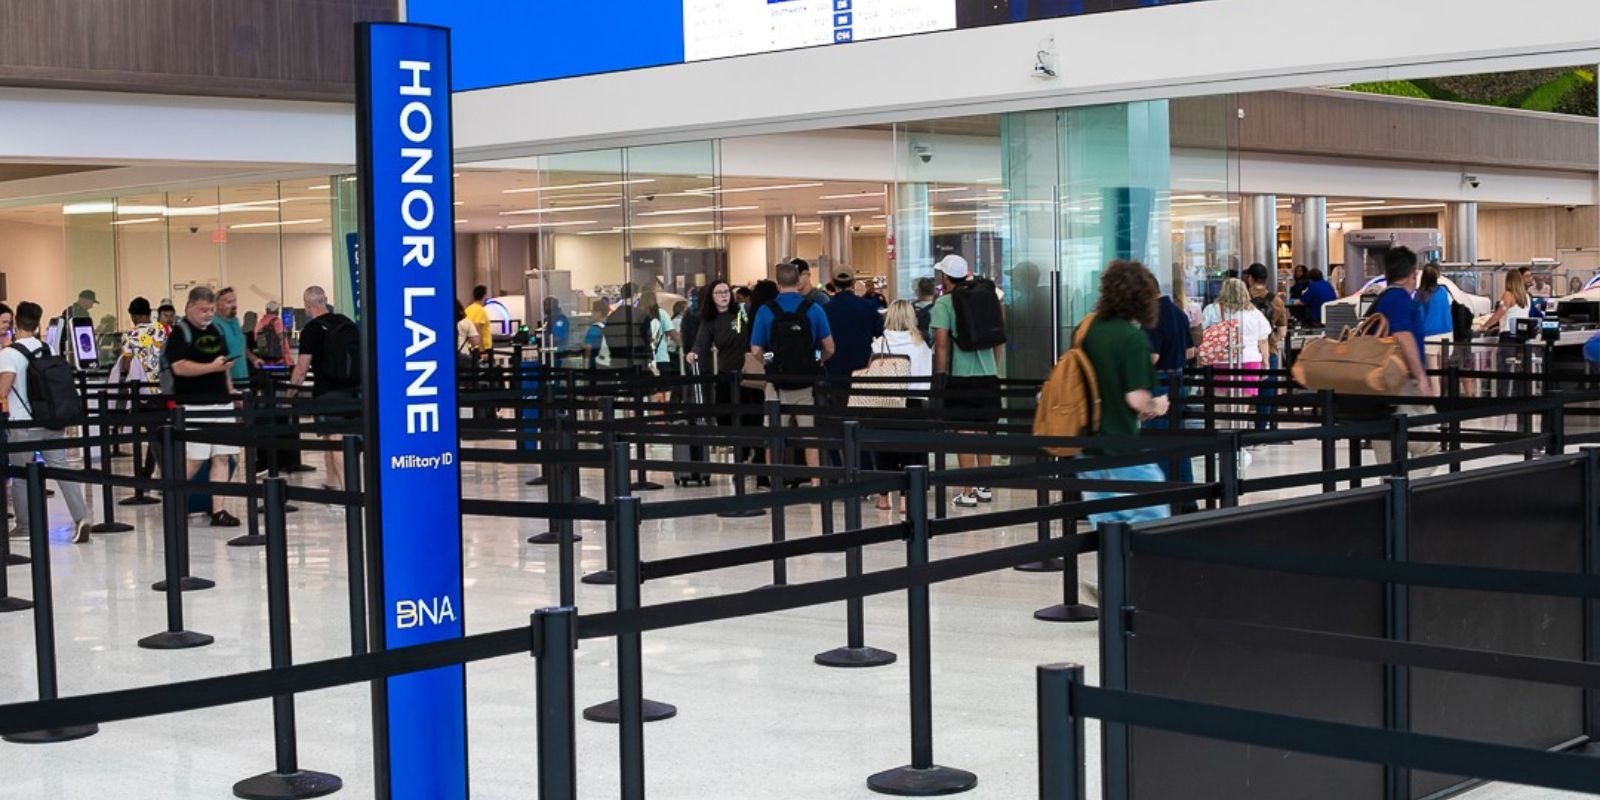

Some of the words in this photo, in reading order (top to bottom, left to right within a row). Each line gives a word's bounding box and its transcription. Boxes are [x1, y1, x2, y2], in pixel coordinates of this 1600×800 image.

[399, 60, 435, 267] HONOR
[403, 287, 440, 434] LANE
[391, 455, 440, 469] Military
[442, 452, 453, 465] ID
[396, 595, 455, 629] BNA
